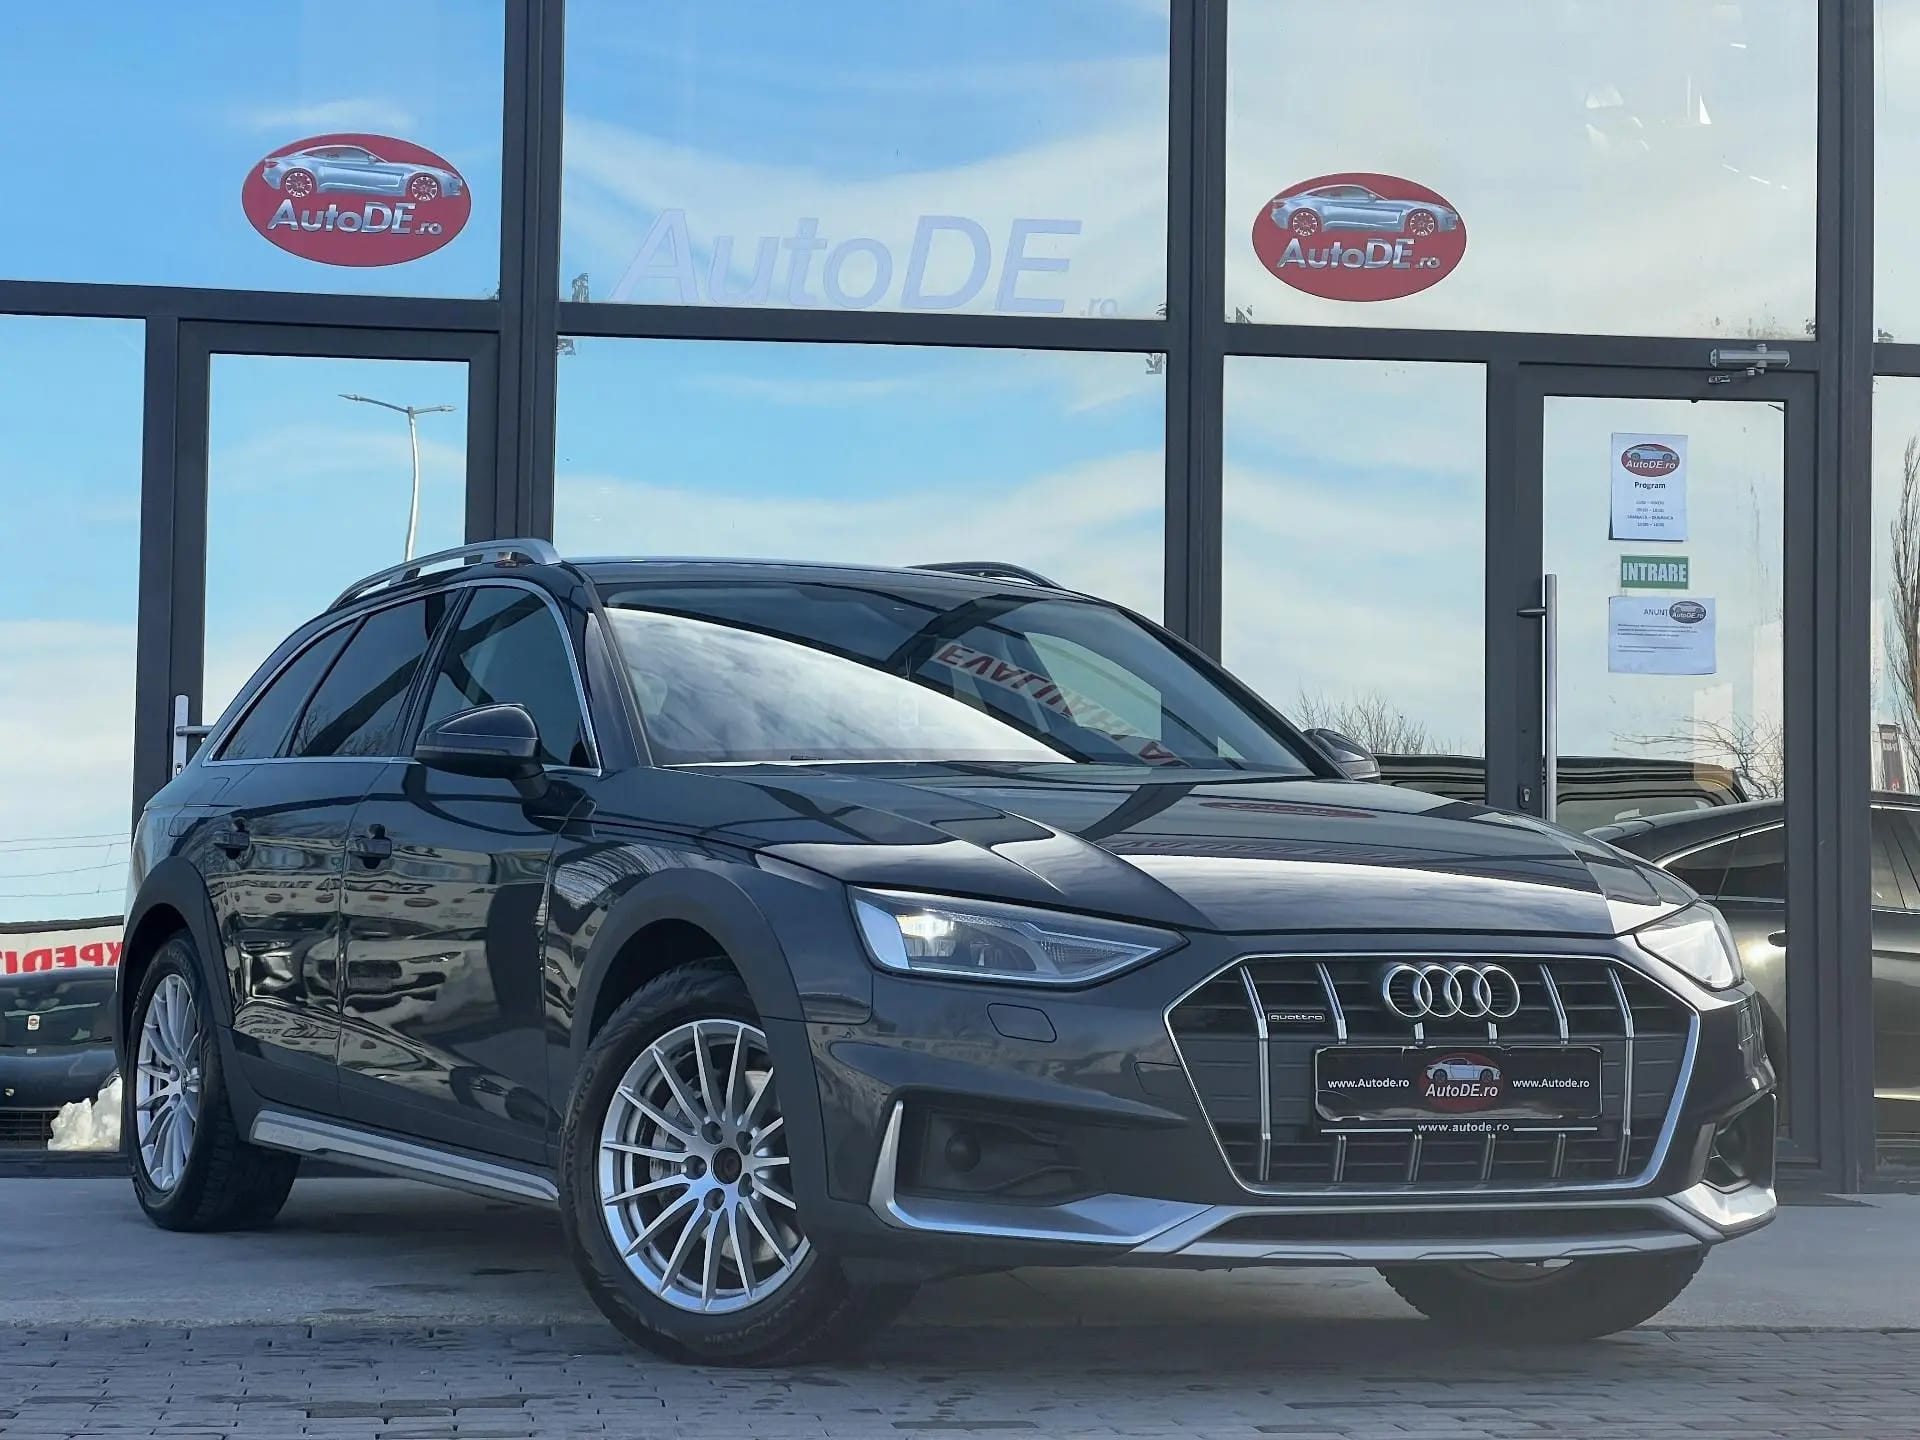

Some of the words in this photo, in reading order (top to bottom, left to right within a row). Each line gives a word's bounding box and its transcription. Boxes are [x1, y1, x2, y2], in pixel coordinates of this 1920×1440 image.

[1625, 459, 1677, 470] AutoDE.ro
[1634, 481, 1666, 490] Program
[1622, 562, 1687, 583] INTRARE
[1269, 1013, 1324, 1022] quattro
[1327, 1077, 1410, 1089] www.Autode.ro
[1512, 1077, 1591, 1089] www.Autode.ro
[1424, 1083, 1499, 1098] AutoDE.ro
[1417, 1122, 1510, 1133] www.autode.ro
